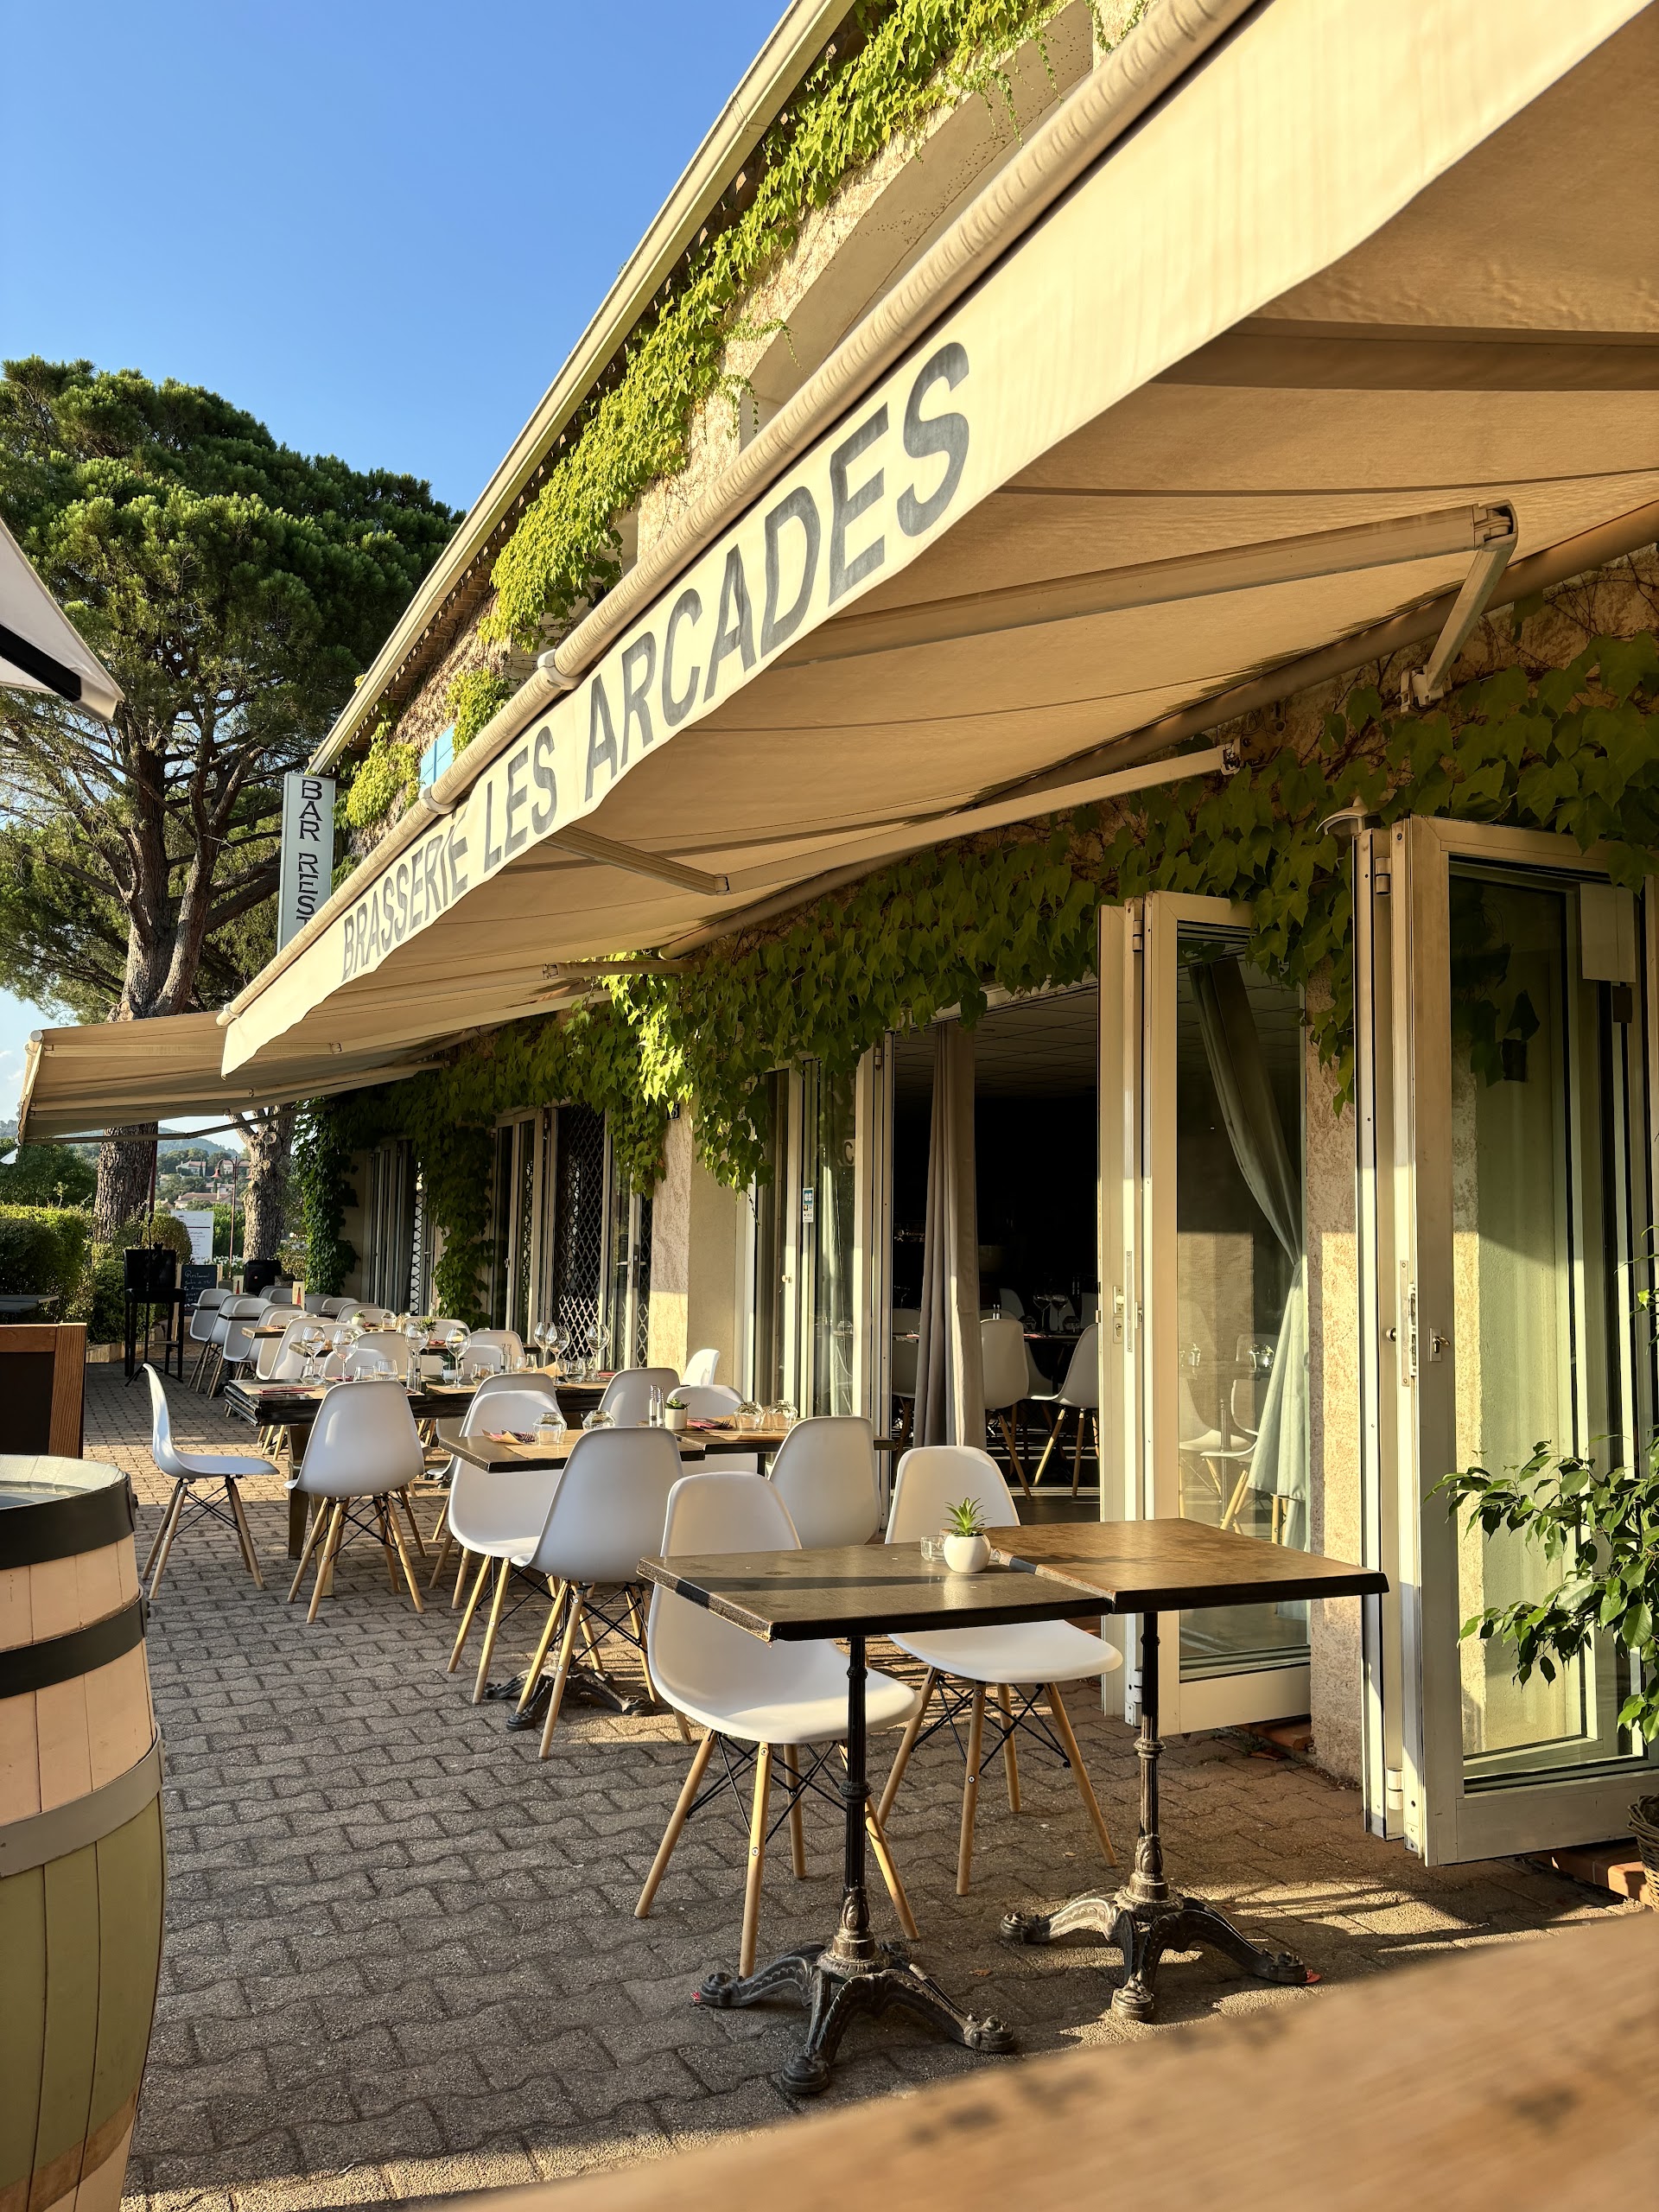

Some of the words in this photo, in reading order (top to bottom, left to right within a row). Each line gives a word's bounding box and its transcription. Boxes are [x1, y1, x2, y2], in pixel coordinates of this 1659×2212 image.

[299, 779, 323, 842] BAR
[341, 810, 468, 982] BRASSERIE
[484, 726, 557, 874] LES
[584, 342, 969, 803] ARCADES
